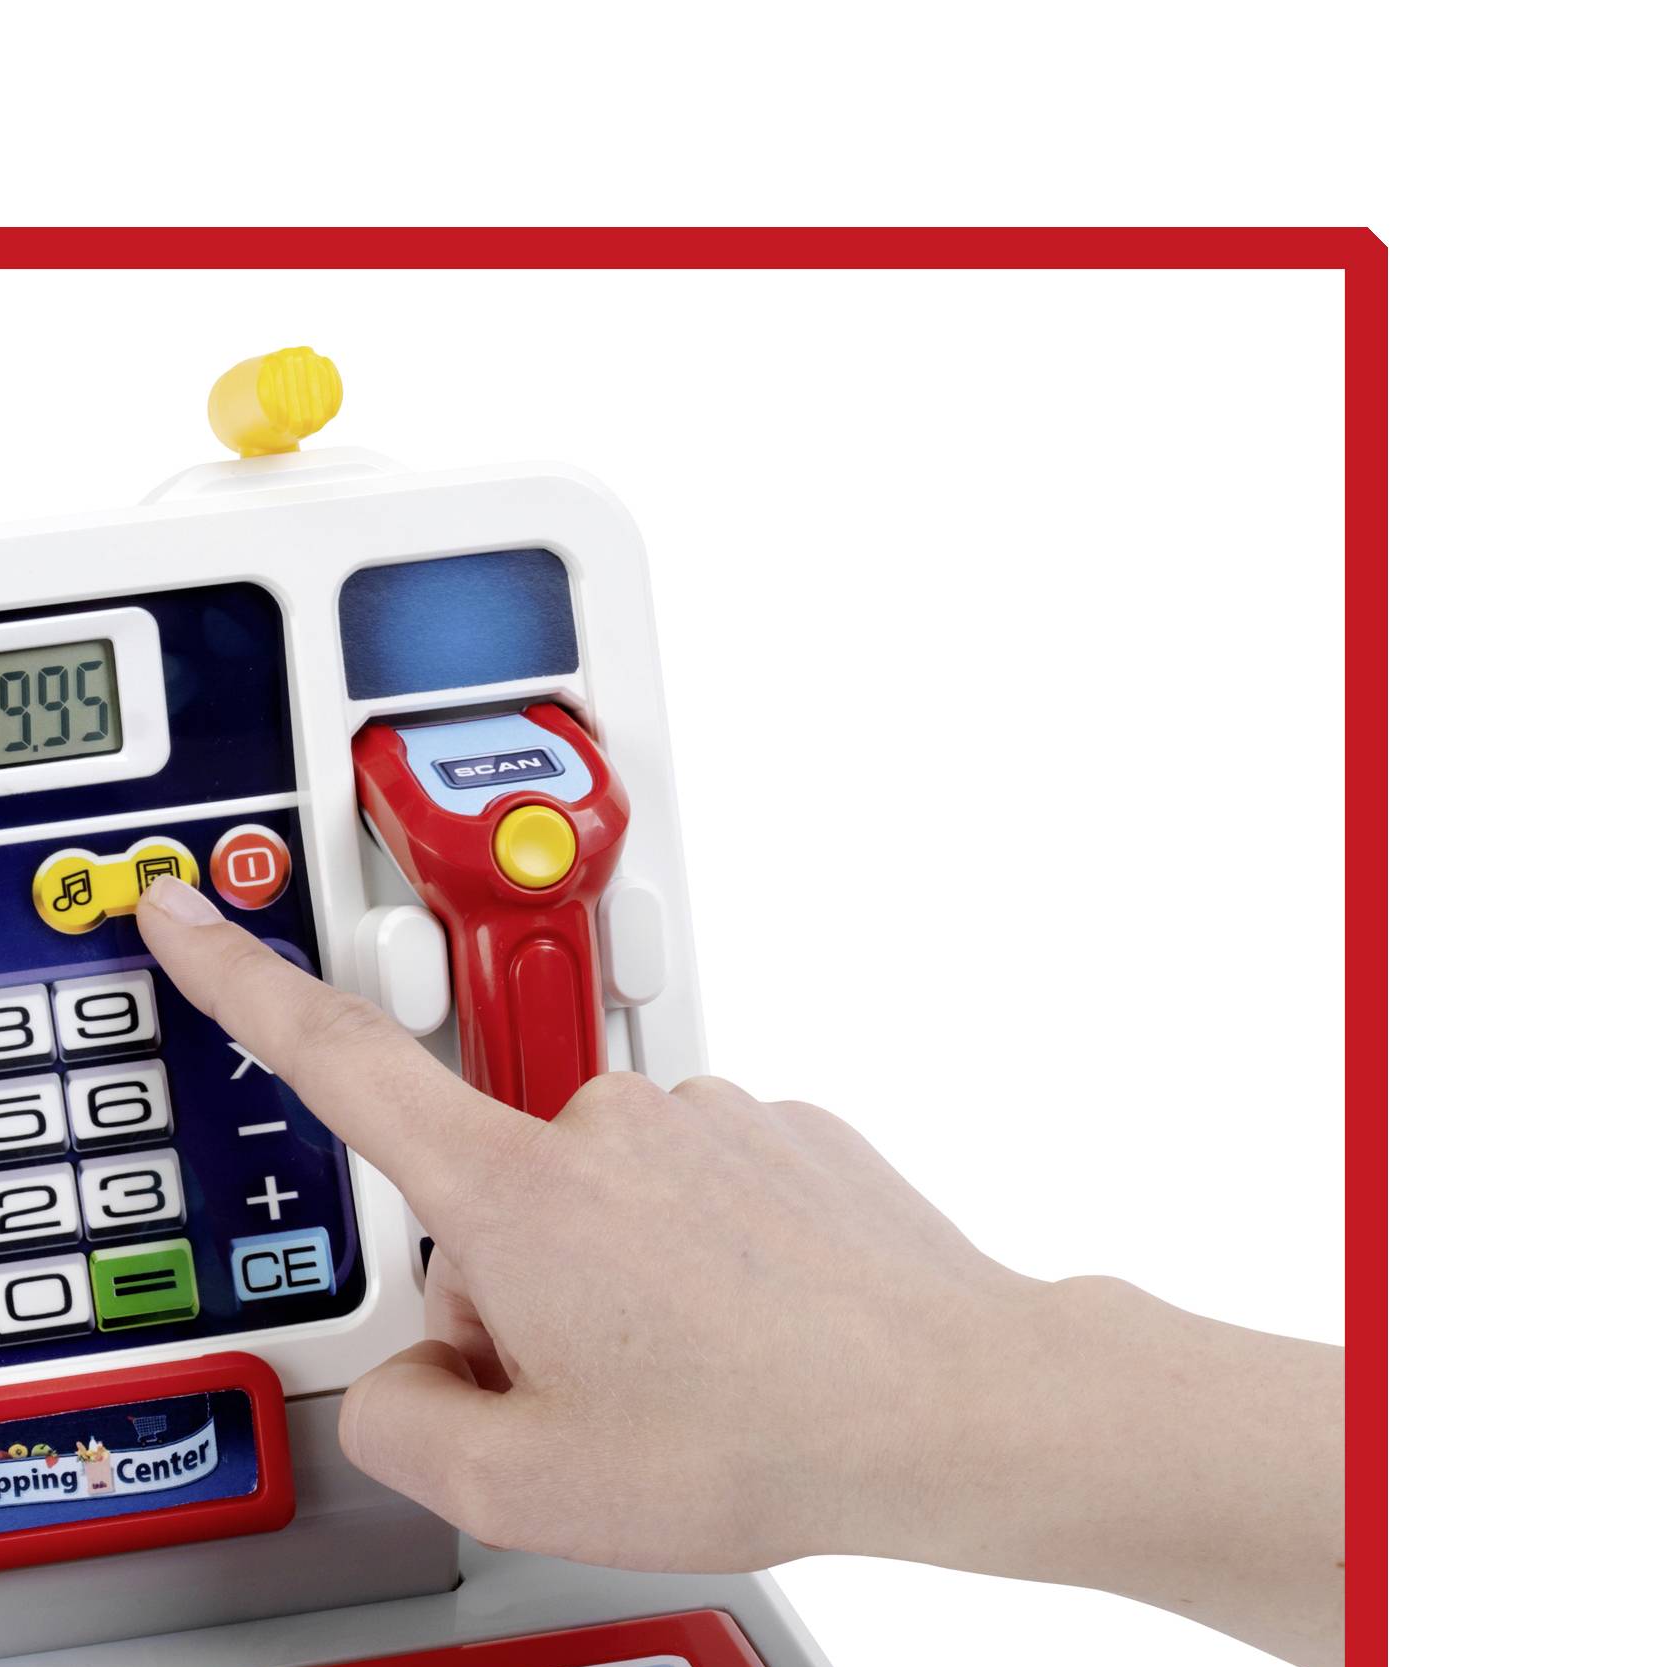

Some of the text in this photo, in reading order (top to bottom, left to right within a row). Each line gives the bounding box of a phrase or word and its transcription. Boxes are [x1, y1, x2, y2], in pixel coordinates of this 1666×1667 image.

[453, 757, 542, 778] SCAN
[74, 991, 140, 1039] 9
[87, 1080, 152, 1129] 6
[99, 1169, 166, 1219] 3
[240, 1244, 321, 1294] CE
[4, 1273, 73, 1322] 0
[116, 1439, 210, 1484] Center
